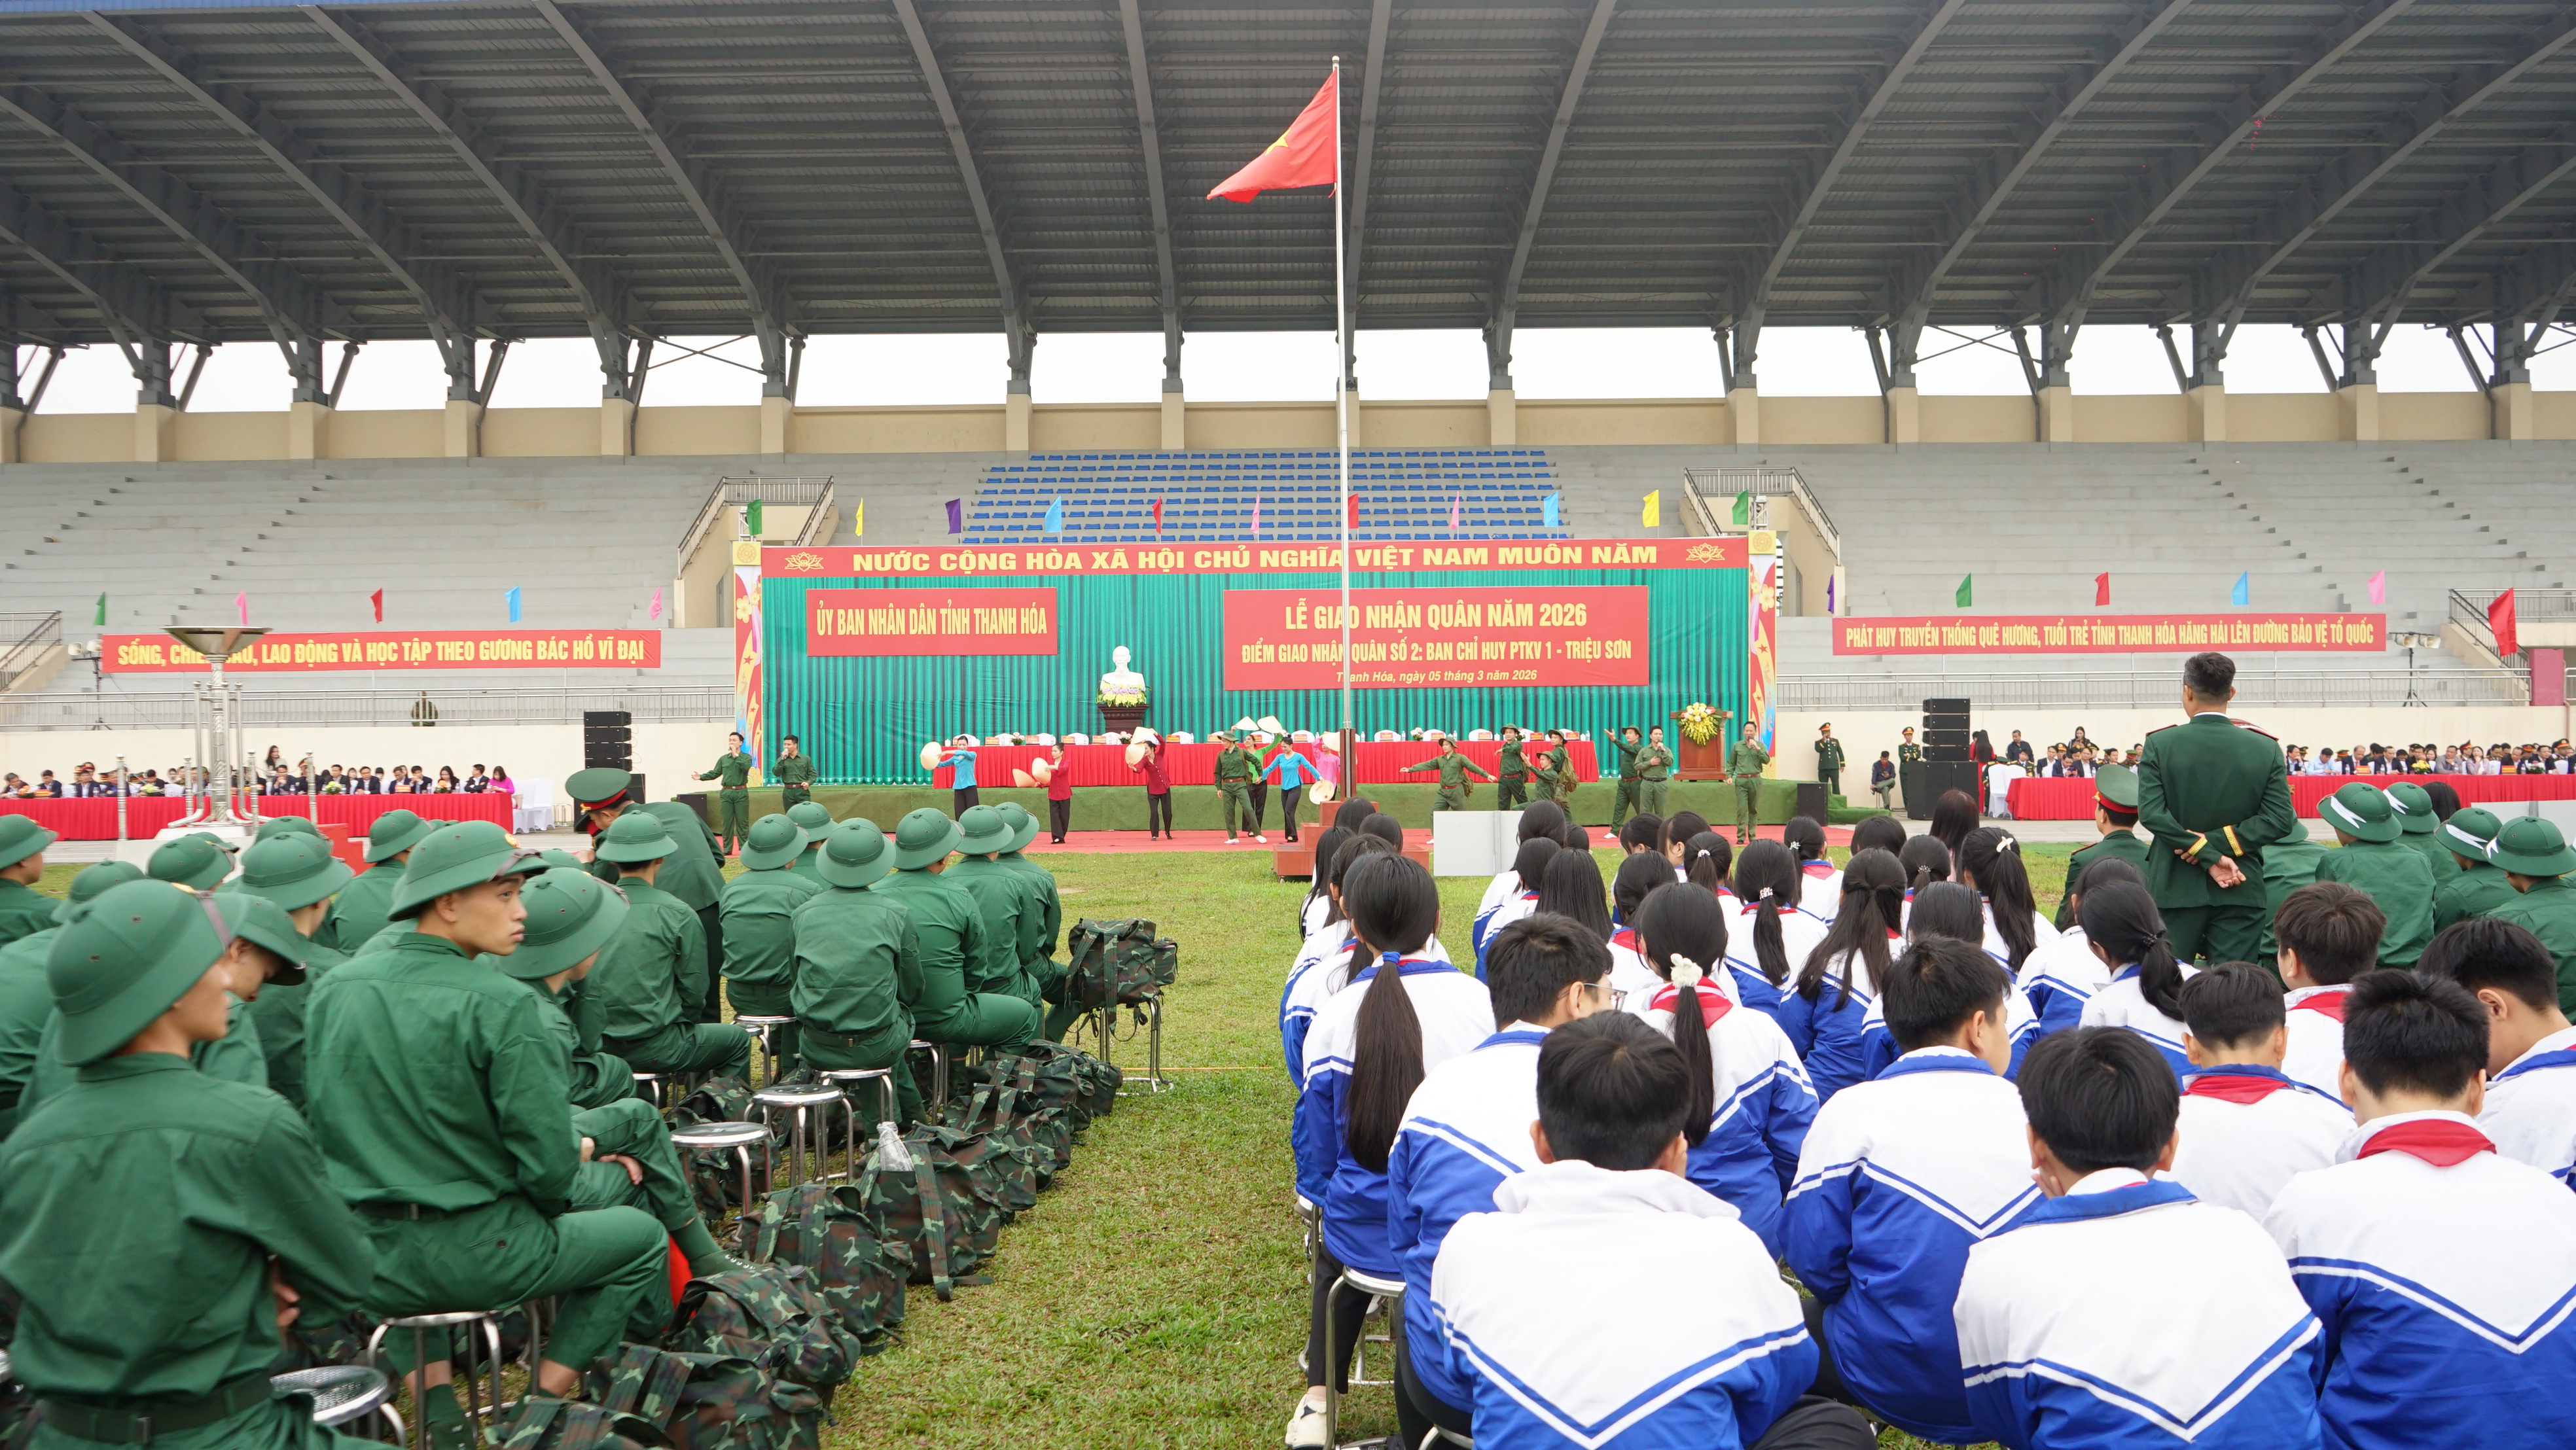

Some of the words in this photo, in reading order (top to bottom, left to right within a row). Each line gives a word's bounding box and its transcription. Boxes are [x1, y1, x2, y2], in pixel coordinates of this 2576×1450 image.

[853, 550, 930, 571] NƯỚC
[939, 549, 1016, 575] CỘNG
[1026, 548, 1083, 570] HÒA
[1090, 548, 1130, 569] XÃ
[1138, 547, 1185, 573] HỘI
[1194, 544, 1250, 569] CHỦ
[1259, 546, 1343, 568] NGHĨA
[1354, 544, 1414, 570] VIỆT
[1423, 547, 1488, 566] NAM
[1498, 543, 1583, 565] MUÔN
[1592, 542, 1657, 564] NĂM
[816, 599, 834, 636] ỦY
[837, 609, 865, 635] BAN
[868, 602, 906, 635] NHÂN
[909, 602, 937, 635] DÂN
[939, 599, 971, 635] TỈNH
[973, 607, 1017, 635] THANH
[1020, 601, 1048, 635] HÓA
[1285, 597, 1308, 629] LỄ
[1314, 605, 1360, 629] GIAO
[1365, 599, 1422, 633] NHẬN
[1427, 599, 1482, 631] QUÂN
[1487, 598, 1533, 628] NĂM
[1539, 603, 1587, 627] 2026
[1846, 623, 1874, 648] PHÁT
[1875, 627, 1897, 648] HUY
[1898, 620, 1939, 647] TRUYỀN
[1941, 619, 1977, 646] THỐNG
[1978, 622, 2000, 648] QUÊ
[2001, 624, 2041, 648] HƯƠNG,
[2043, 618, 2067, 646] TUỔI
[2069, 619, 2089, 646] TRẺ
[2090, 618, 2116, 646] TỈNH
[2117, 624, 2153, 645] THANH
[2155, 620, 2177, 645] HÓA
[2178, 620, 2208, 645] HĂNG
[2209, 620, 2228, 644] HÁI
[2230, 619, 2251, 644] LÊN
[2252, 618, 2289, 644] ĐƯỜNG
[2291, 617, 2313, 644] BẢO
[2314, 619, 2328, 648] VỆ
[2329, 616, 2344, 644] TỔ
[2345, 616, 2374, 646] QUỐC
[117, 638, 167, 667] SỐNG,
[170, 644, 211, 664] CHI
[261, 643, 291, 663] LAO
[294, 639, 338, 667] ĐỘNG
[341, 638, 363, 663] VÀ
[366, 641, 399, 666] HỌC
[401, 637, 433, 666] TẬP
[435, 641, 475, 661] THEO
[478, 638, 533, 661] GƯƠNG
[537, 635, 569, 660] BÁC
[573, 633, 594, 660] HỒ
[598, 636, 615, 660] VĨ
[617, 639, 644, 665] ĐẠI
[1241, 637, 1275, 663] ĐIỂM
[1278, 643, 1308, 663] GIAO
[1351, 639, 1387, 664] QUÂN
[1389, 636, 1408, 662] SỐ
[1410, 642, 1423, 661] 2:
[1426, 642, 1453, 661] BAN
[1456, 635, 1478, 661] CHỈ
[1481, 641, 1507, 660] HUY
[1510, 641, 1542, 660] PTKV
[1545, 641, 1552, 660] 1
[1565, 637, 1601, 663] TRIỆU
[1604, 638, 1632, 660] SƠN
[1336, 671, 1369, 682] Tanh
[1372, 671, 1396, 683] Hóa,
[1399, 670, 1426, 684] ngày
[1428, 670, 1442, 682] 05
[1444, 669, 1475, 684] tháng
[1476, 669, 1484, 681] 3
[1486, 669, 1510, 681] năm
[1511, 669, 1537, 681] 2026
